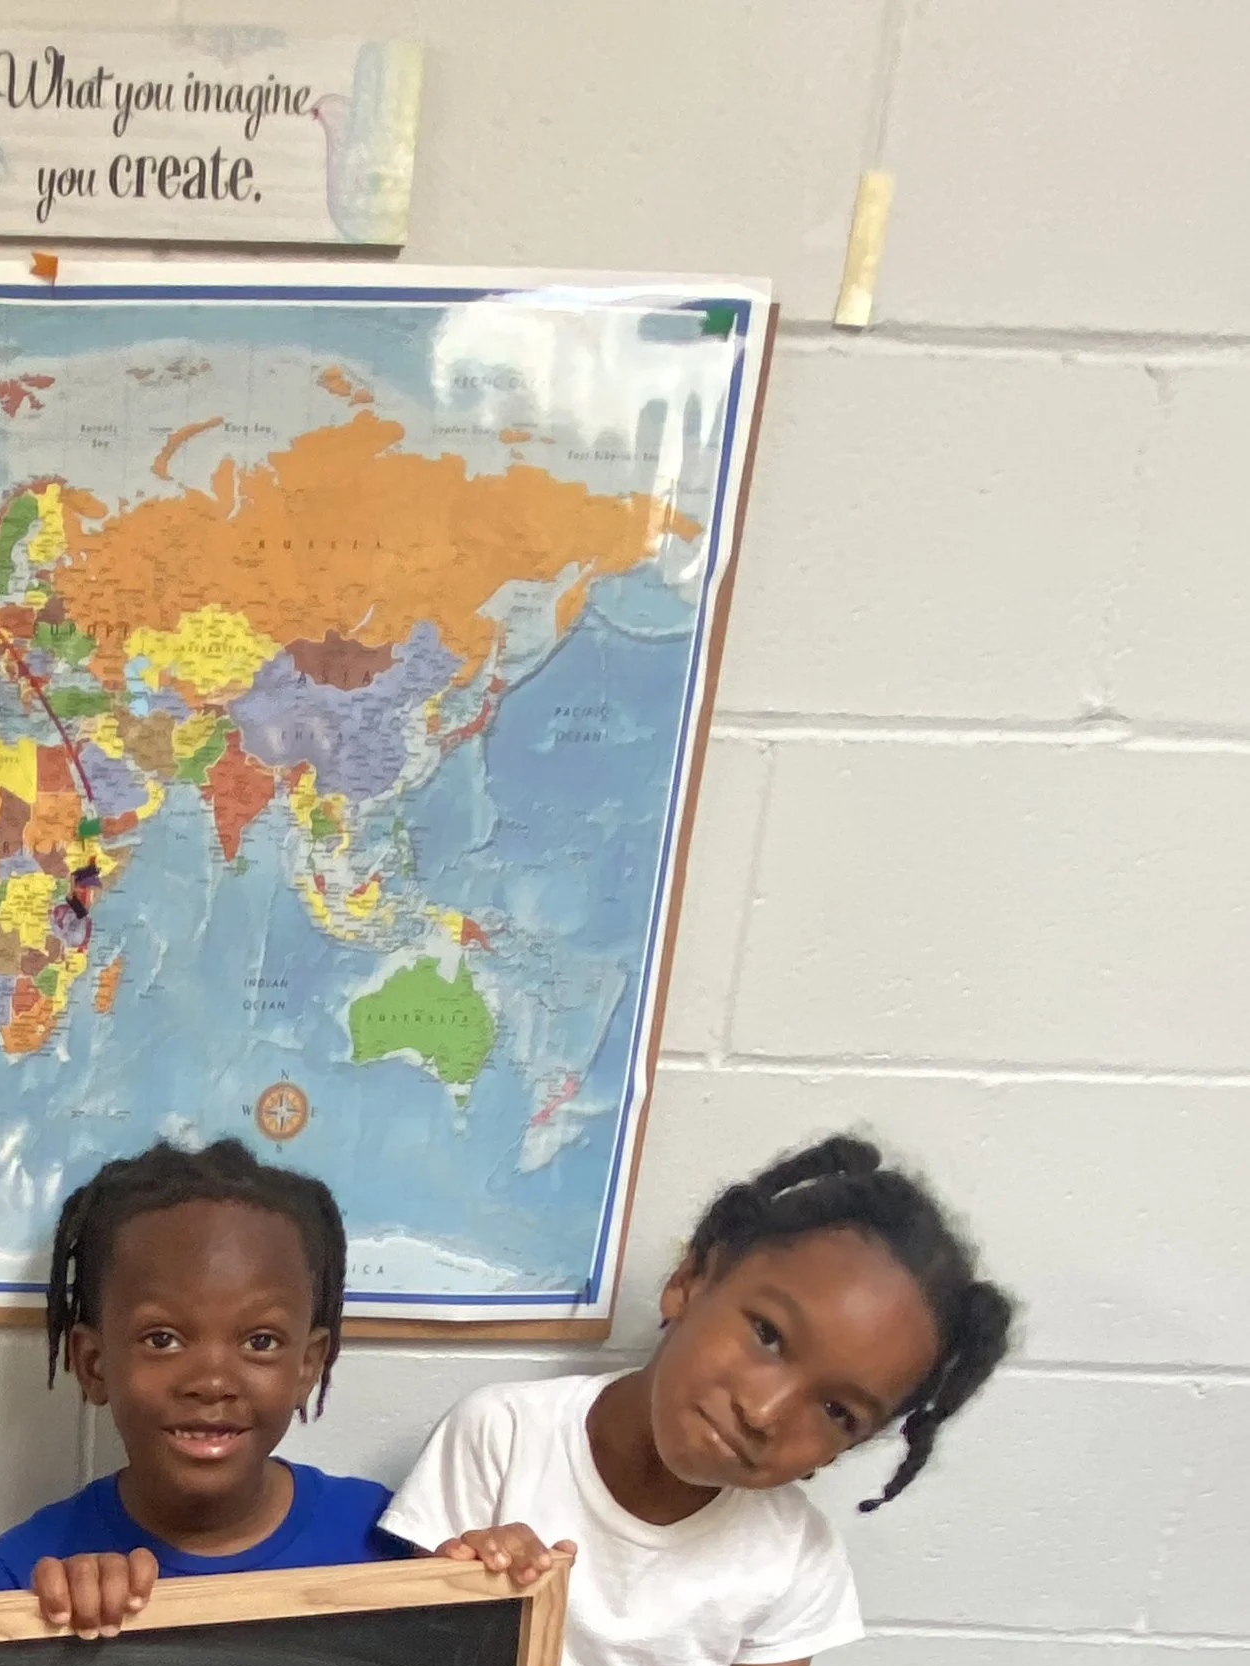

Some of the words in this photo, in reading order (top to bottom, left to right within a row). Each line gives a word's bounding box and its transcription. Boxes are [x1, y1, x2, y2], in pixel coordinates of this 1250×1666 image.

[114, 83, 175, 138] you
[183, 72, 313, 140] imagine
[36, 165, 97, 223] you
[108, 147, 262, 202] create.
